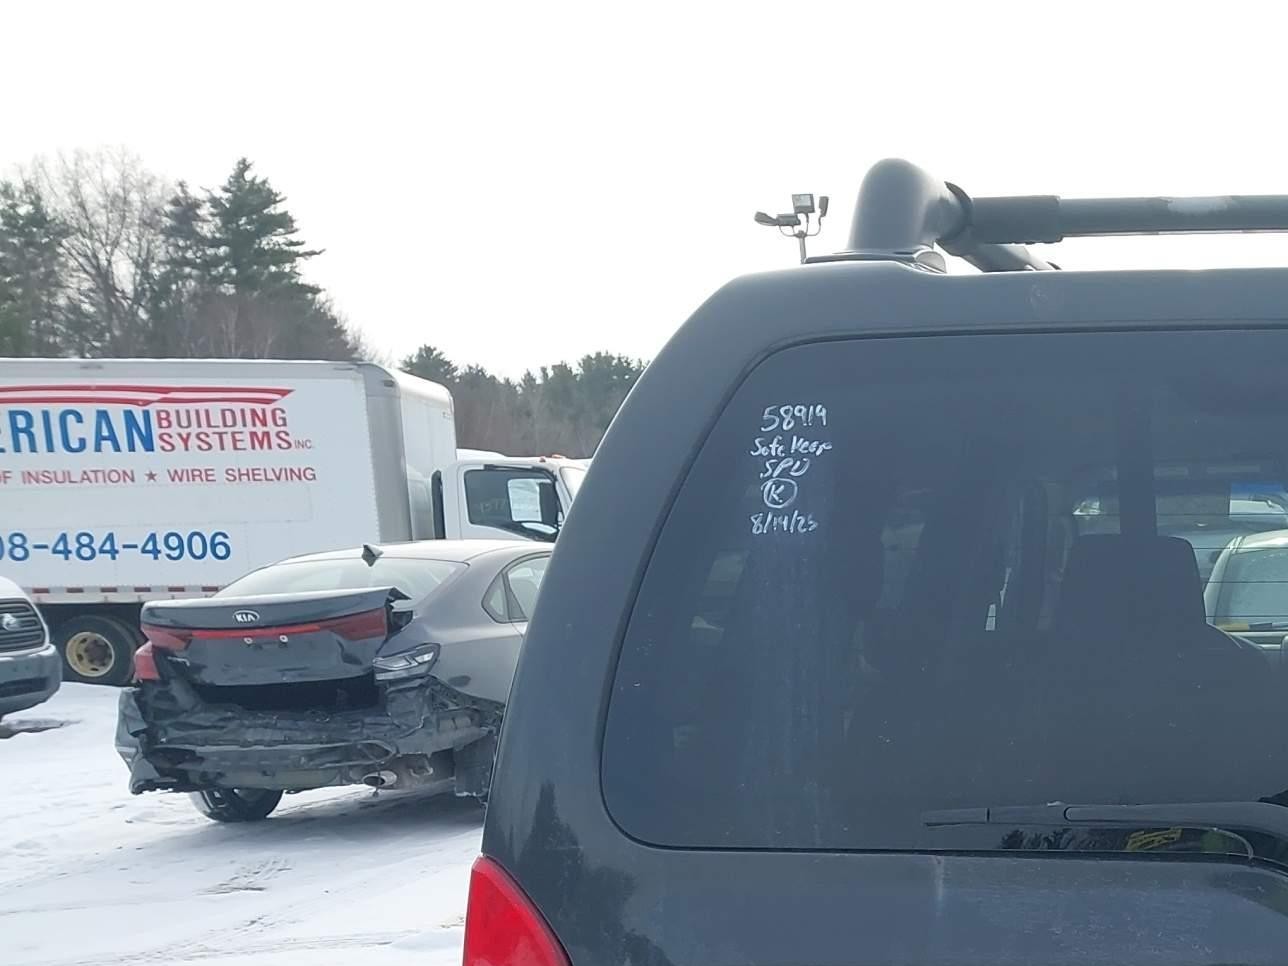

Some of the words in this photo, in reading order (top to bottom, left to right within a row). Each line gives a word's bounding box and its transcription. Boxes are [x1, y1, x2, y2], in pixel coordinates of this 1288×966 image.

[0, 409, 155, 453] RICAN
[156, 407, 288, 429] BUILDING
[158, 431, 292, 452] SYSTEMS
[0, 470, 12, 484] F
[21, 469, 135, 484] INSULATION
[167, 468, 217, 483] WIRE
[225, 467, 317, 482] SHELVING
[0, 531, 231, 561] 8-484-4906
[235, 613, 256, 622] KIA
